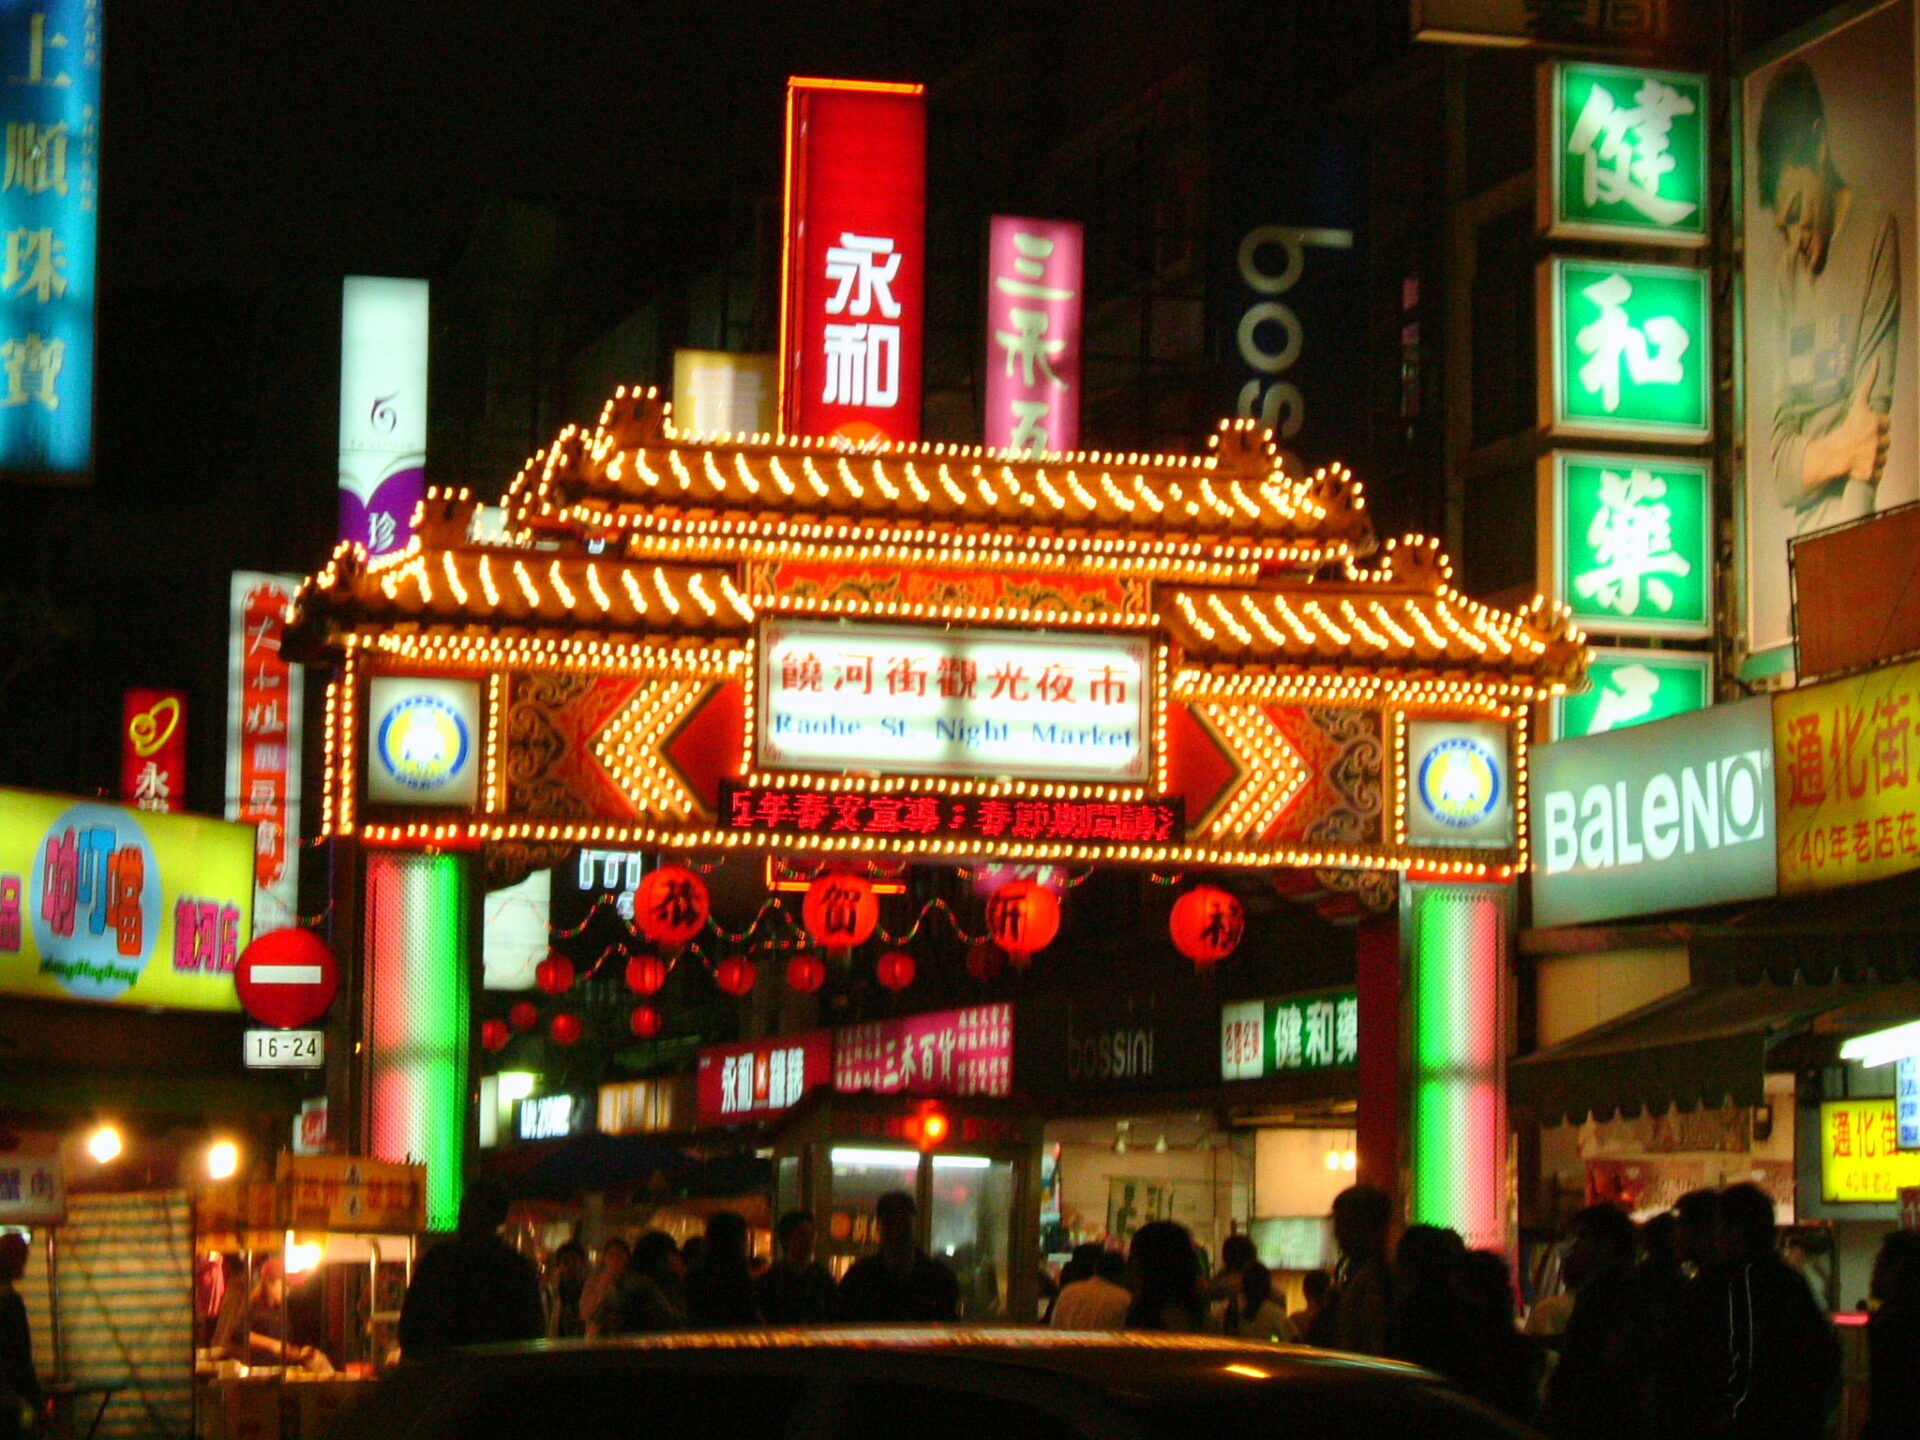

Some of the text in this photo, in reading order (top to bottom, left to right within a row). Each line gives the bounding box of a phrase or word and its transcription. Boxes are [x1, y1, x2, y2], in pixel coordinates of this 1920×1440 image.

[822, 231, 902, 408] 永和
[780, 651, 1128, 706] 饒河街觀光夜市
[775, 713, 862, 736] Raohe
[935, 718, 1009, 748] Night
[1032, 722, 1132, 748] Market
[1787, 692, 1920, 810] 通化街
[258, 1037, 316, 1058] 16-24
